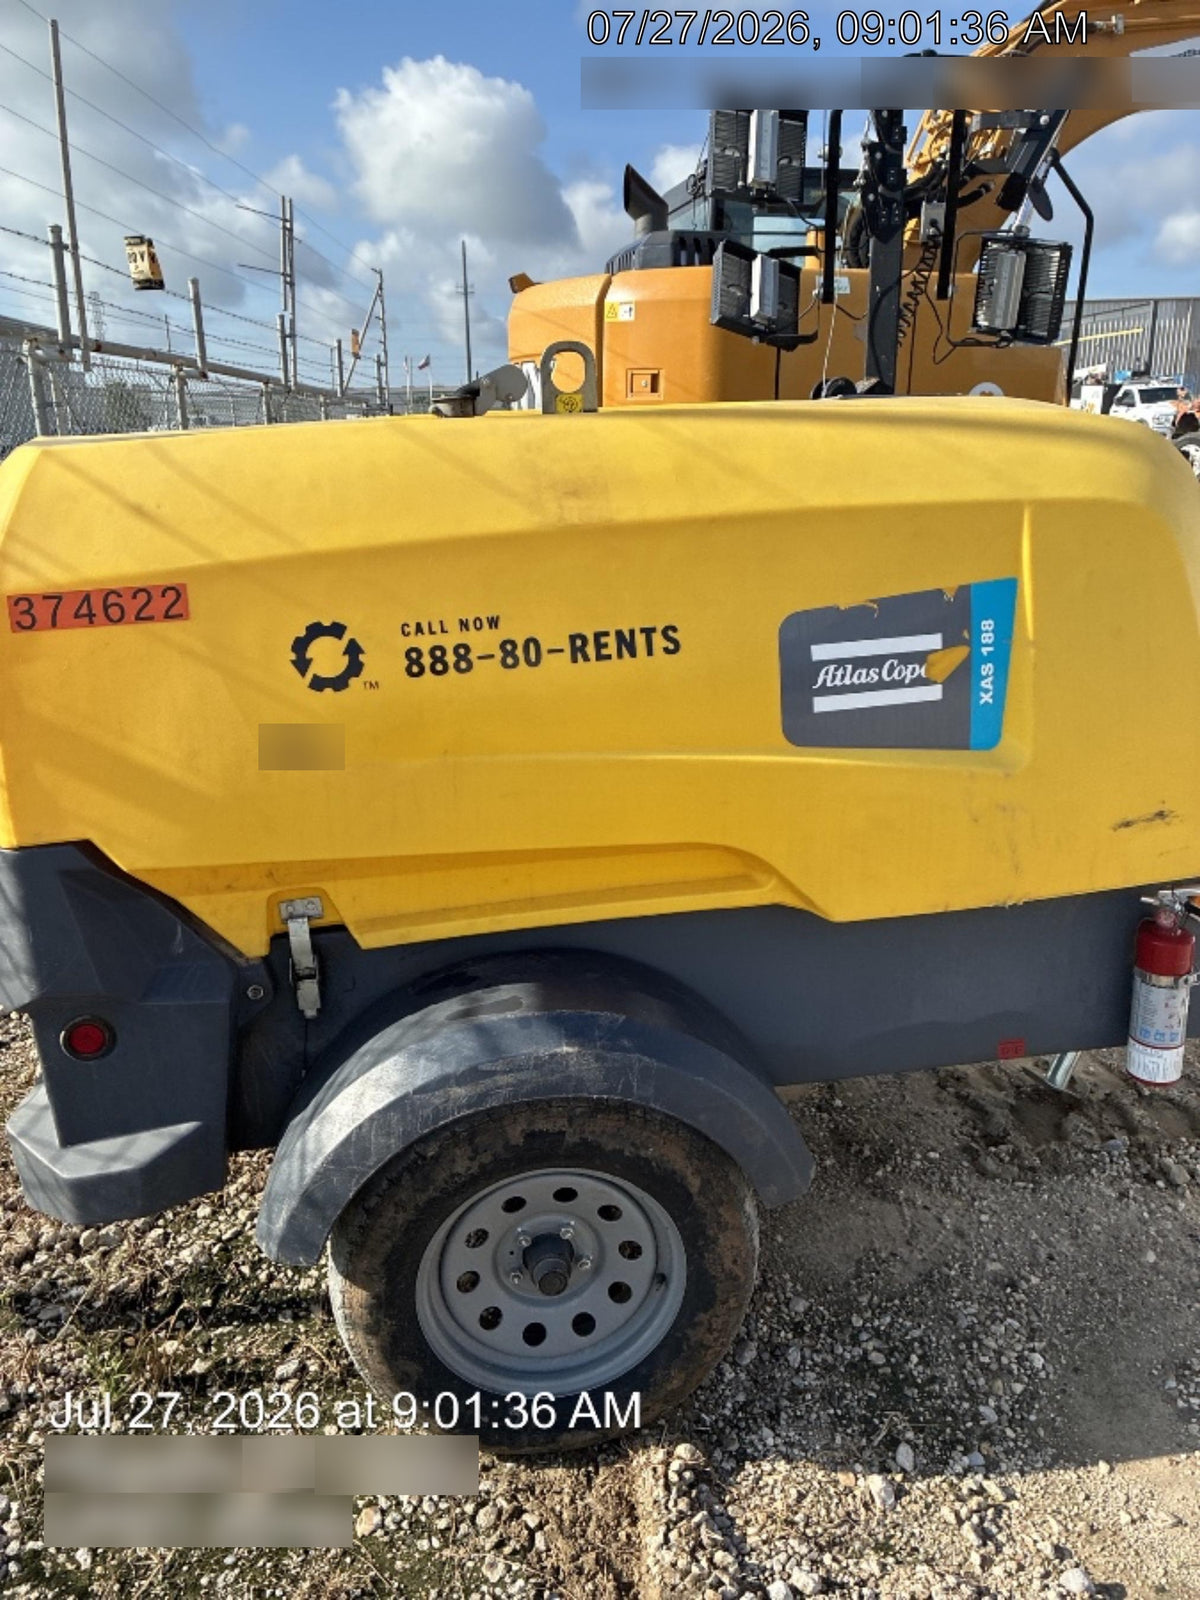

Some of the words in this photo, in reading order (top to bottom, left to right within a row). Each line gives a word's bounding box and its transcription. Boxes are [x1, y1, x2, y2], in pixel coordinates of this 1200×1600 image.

[13, 586, 184, 630] 374622
[401, 620, 449, 637] CALL
[459, 615, 501, 632] NOW
[404, 624, 682, 678] 888-80-RENTS
[981, 618, 995, 656] 188
[812, 664, 880, 689] Atlas
[979, 663, 995, 705] XAS
